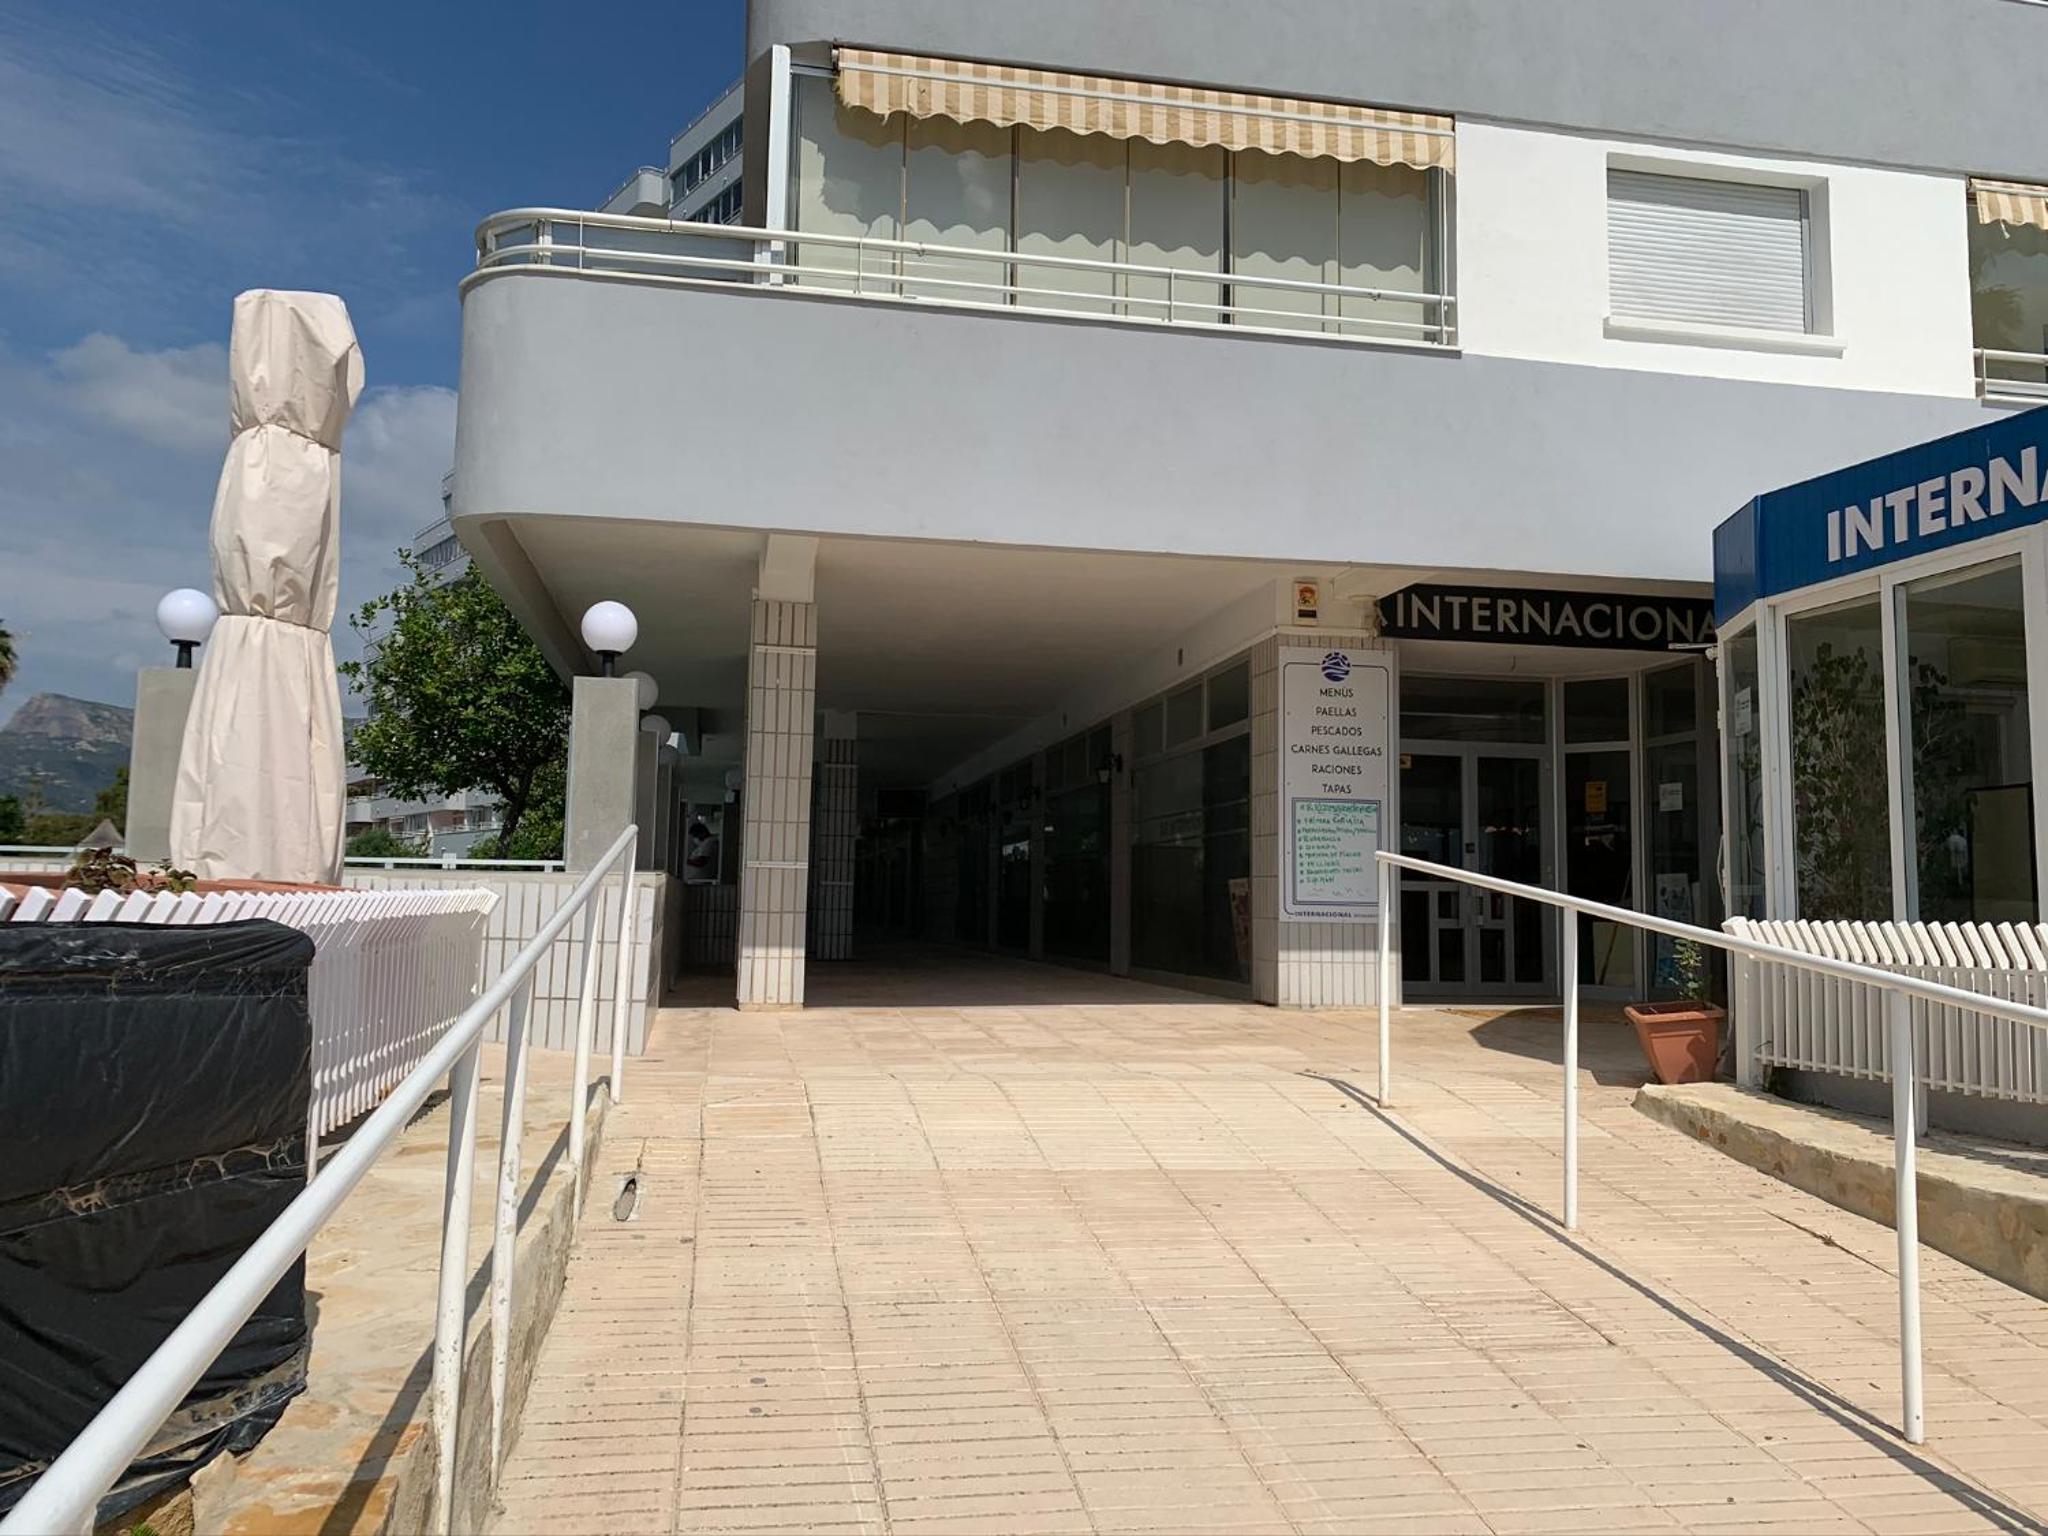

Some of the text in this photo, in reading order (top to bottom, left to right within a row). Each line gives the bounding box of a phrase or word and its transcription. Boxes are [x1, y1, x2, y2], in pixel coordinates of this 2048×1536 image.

[1827, 446, 2048, 562] INTERN
[1315, 706, 1357, 717] PAELLAS
[1311, 725, 1362, 736] PESCADOS
[1291, 744, 1382, 757] CARNES GALLEGAS
[1311, 764, 1362, 775] RACIONES
[1322, 783, 1351, 794] TAPAS
